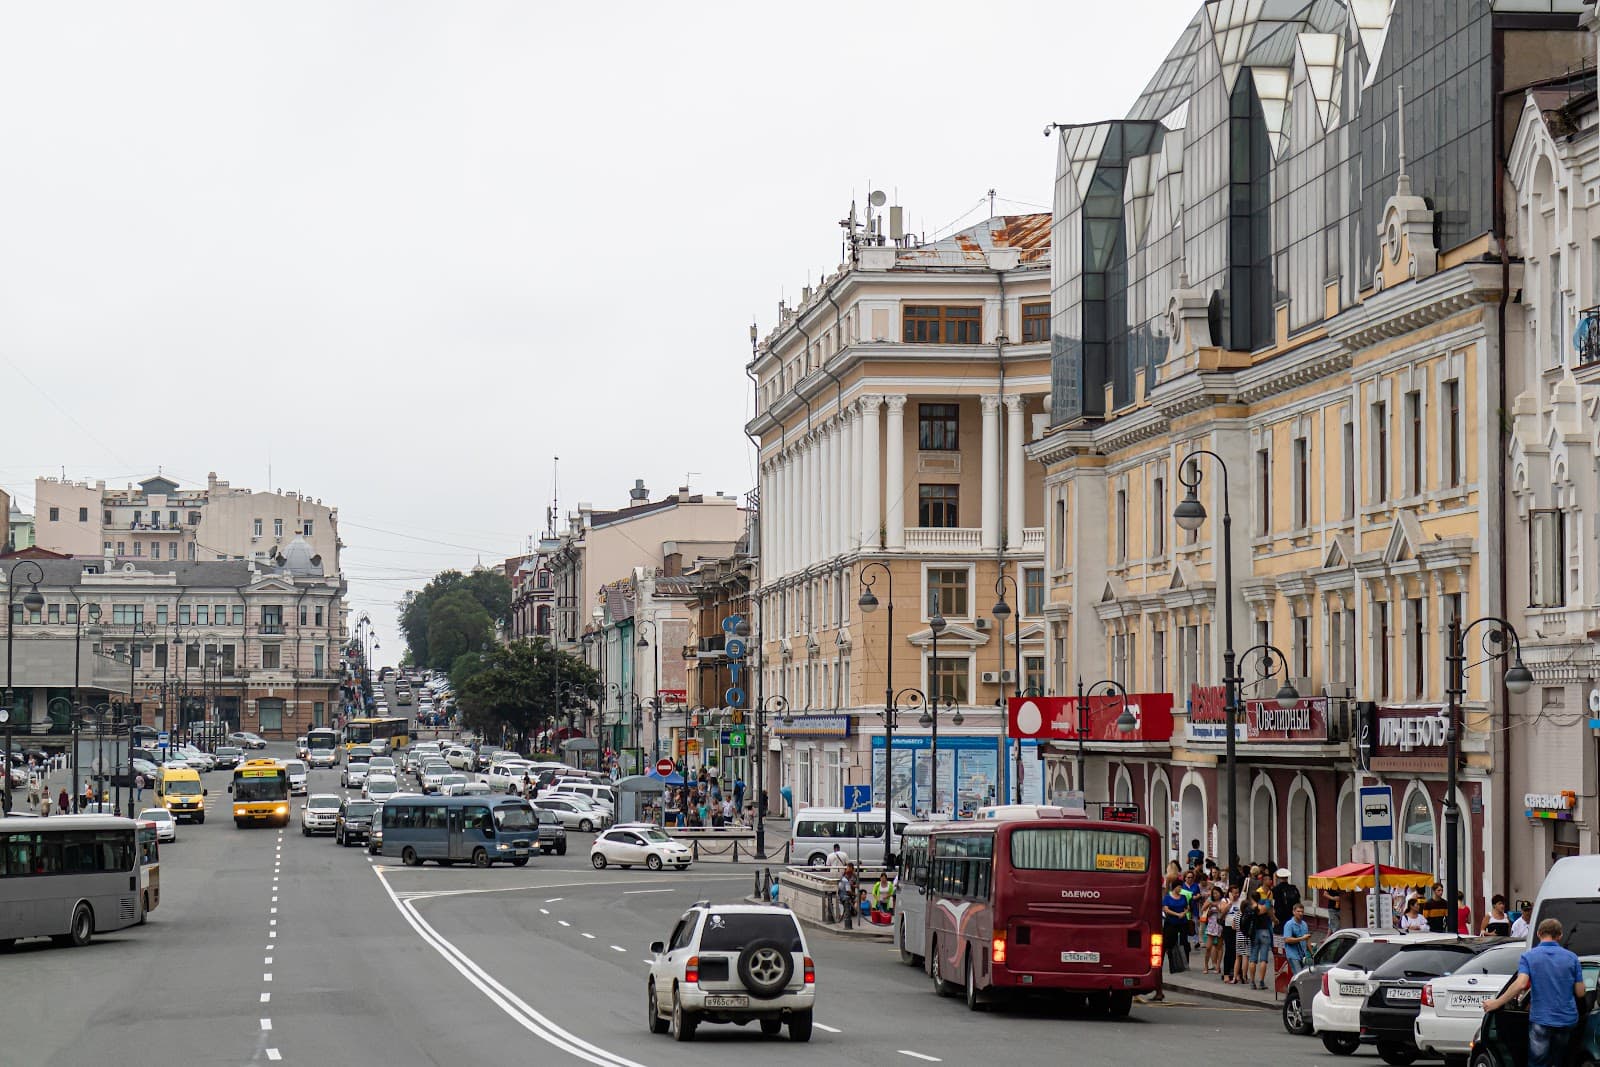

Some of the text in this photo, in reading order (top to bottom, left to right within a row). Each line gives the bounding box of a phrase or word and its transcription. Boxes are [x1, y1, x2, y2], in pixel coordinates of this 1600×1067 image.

[722, 614, 746, 708] ФОТО
[1255, 700, 1310, 739] Ювелирный
[1061, 890, 1100, 898] DAEWOO
